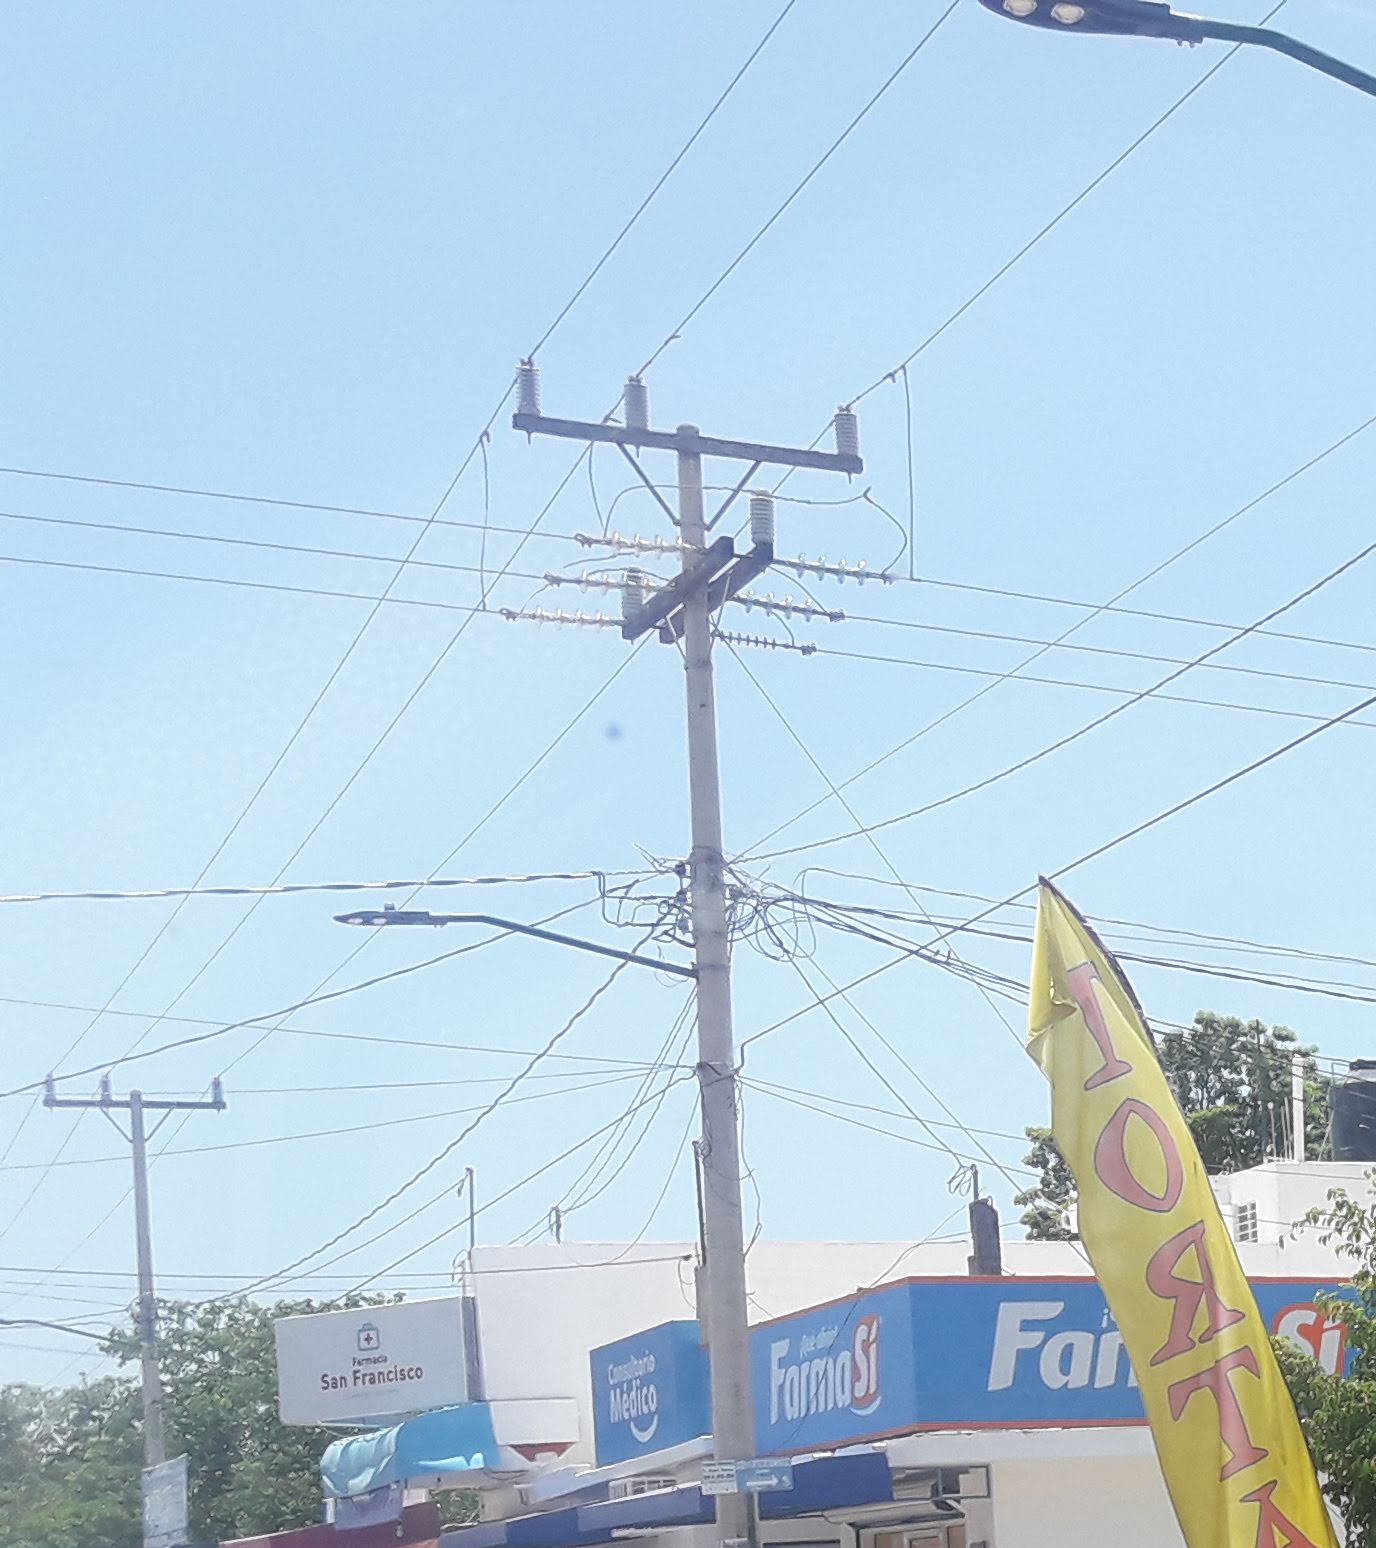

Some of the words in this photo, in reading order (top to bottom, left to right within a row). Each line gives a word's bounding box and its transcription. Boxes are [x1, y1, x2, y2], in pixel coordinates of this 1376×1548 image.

[321, 1373, 348, 1391] San
[352, 1365, 424, 1387] Francisco
[352, 1354, 388, 1367] Farmacia
[608, 1349, 656, 1385] Consultorio
[771, 1319, 879, 1424] FarmaSí
[610, 1379, 657, 1424] Médico
